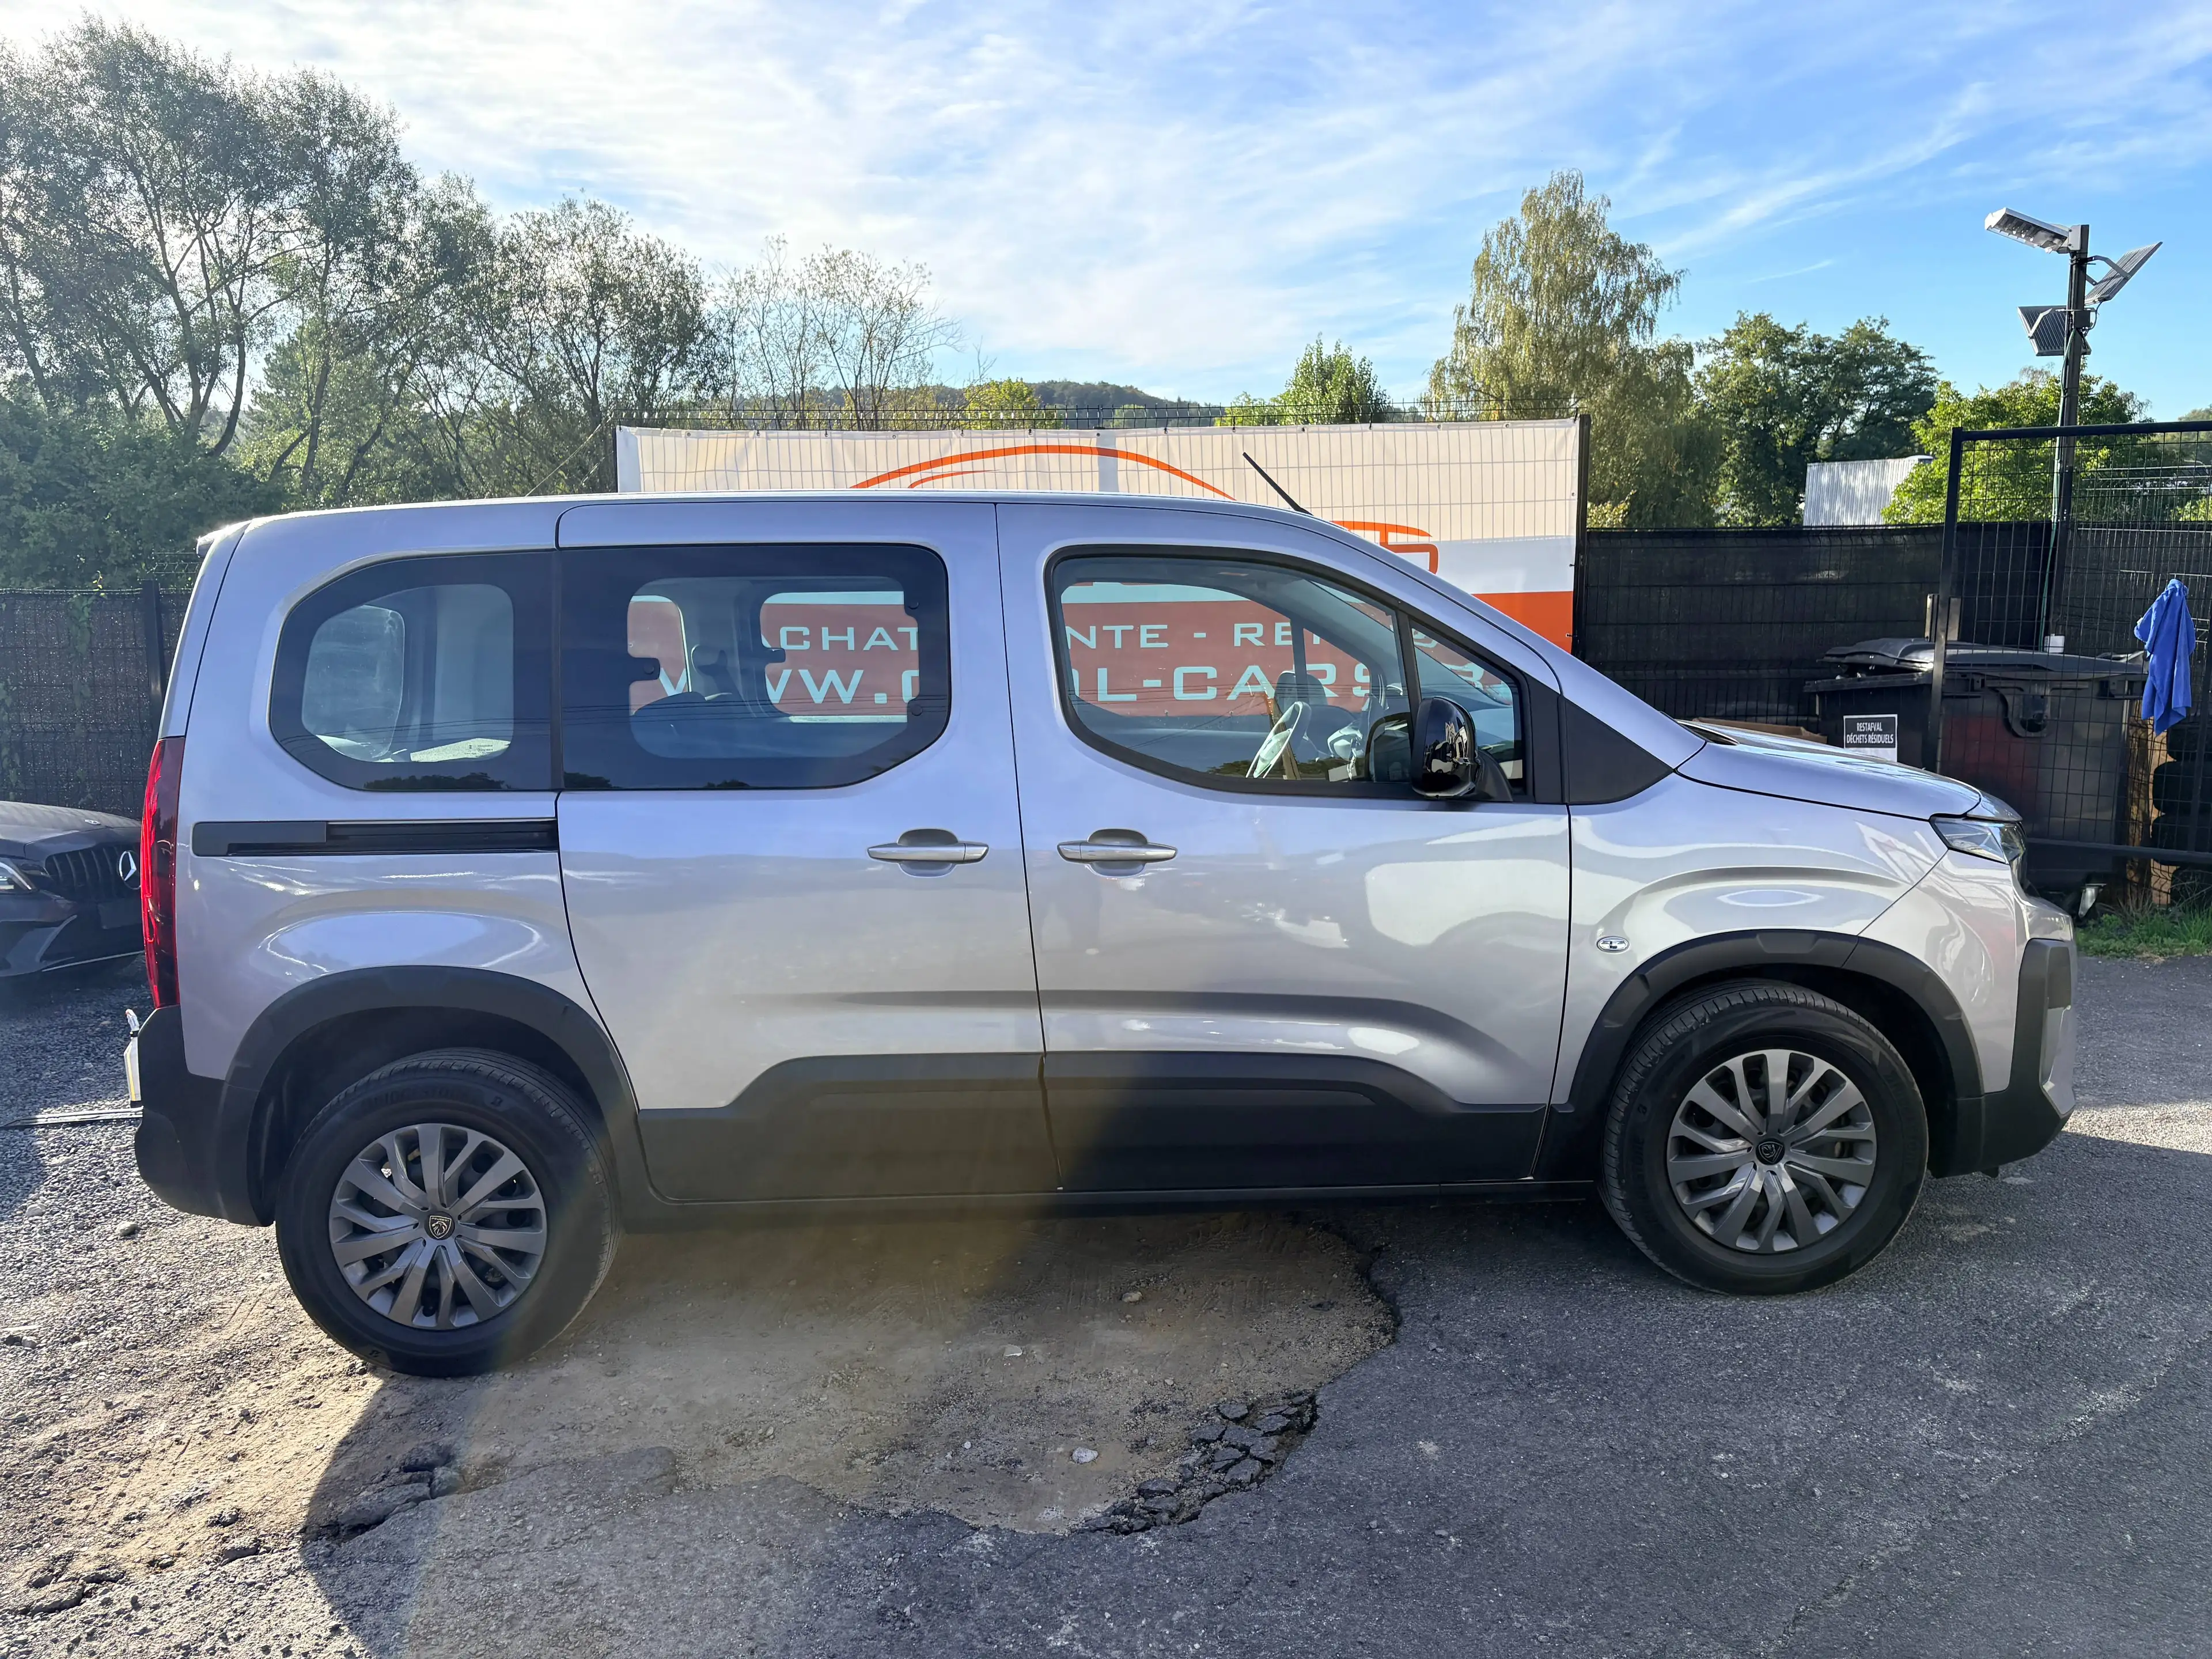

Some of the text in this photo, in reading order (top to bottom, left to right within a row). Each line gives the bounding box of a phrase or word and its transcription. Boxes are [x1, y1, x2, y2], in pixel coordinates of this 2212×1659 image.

[1857, 722, 1883, 732] RESTAFVAL
[1846, 732, 1893, 744] DÉCHETS RÉSIDUELS
